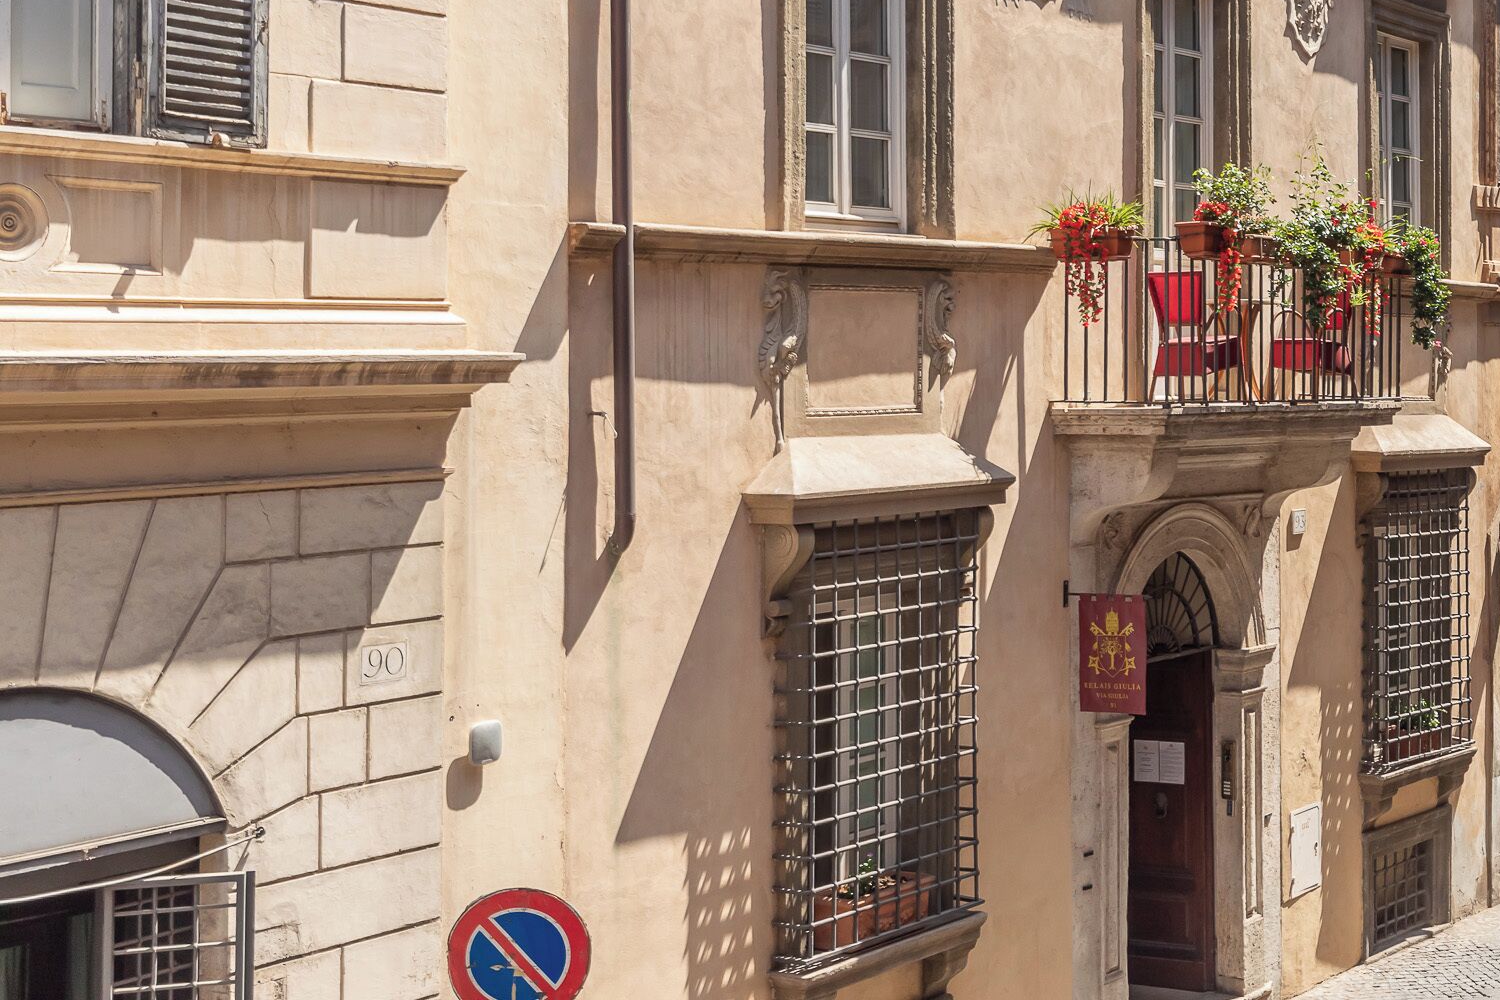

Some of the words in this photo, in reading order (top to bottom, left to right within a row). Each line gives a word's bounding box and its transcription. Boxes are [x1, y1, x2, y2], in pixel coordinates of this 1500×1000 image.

[1295, 514, 1306, 529] 93
[363, 646, 404, 678] 90
[1113, 682, 1141, 691] GIULIA
